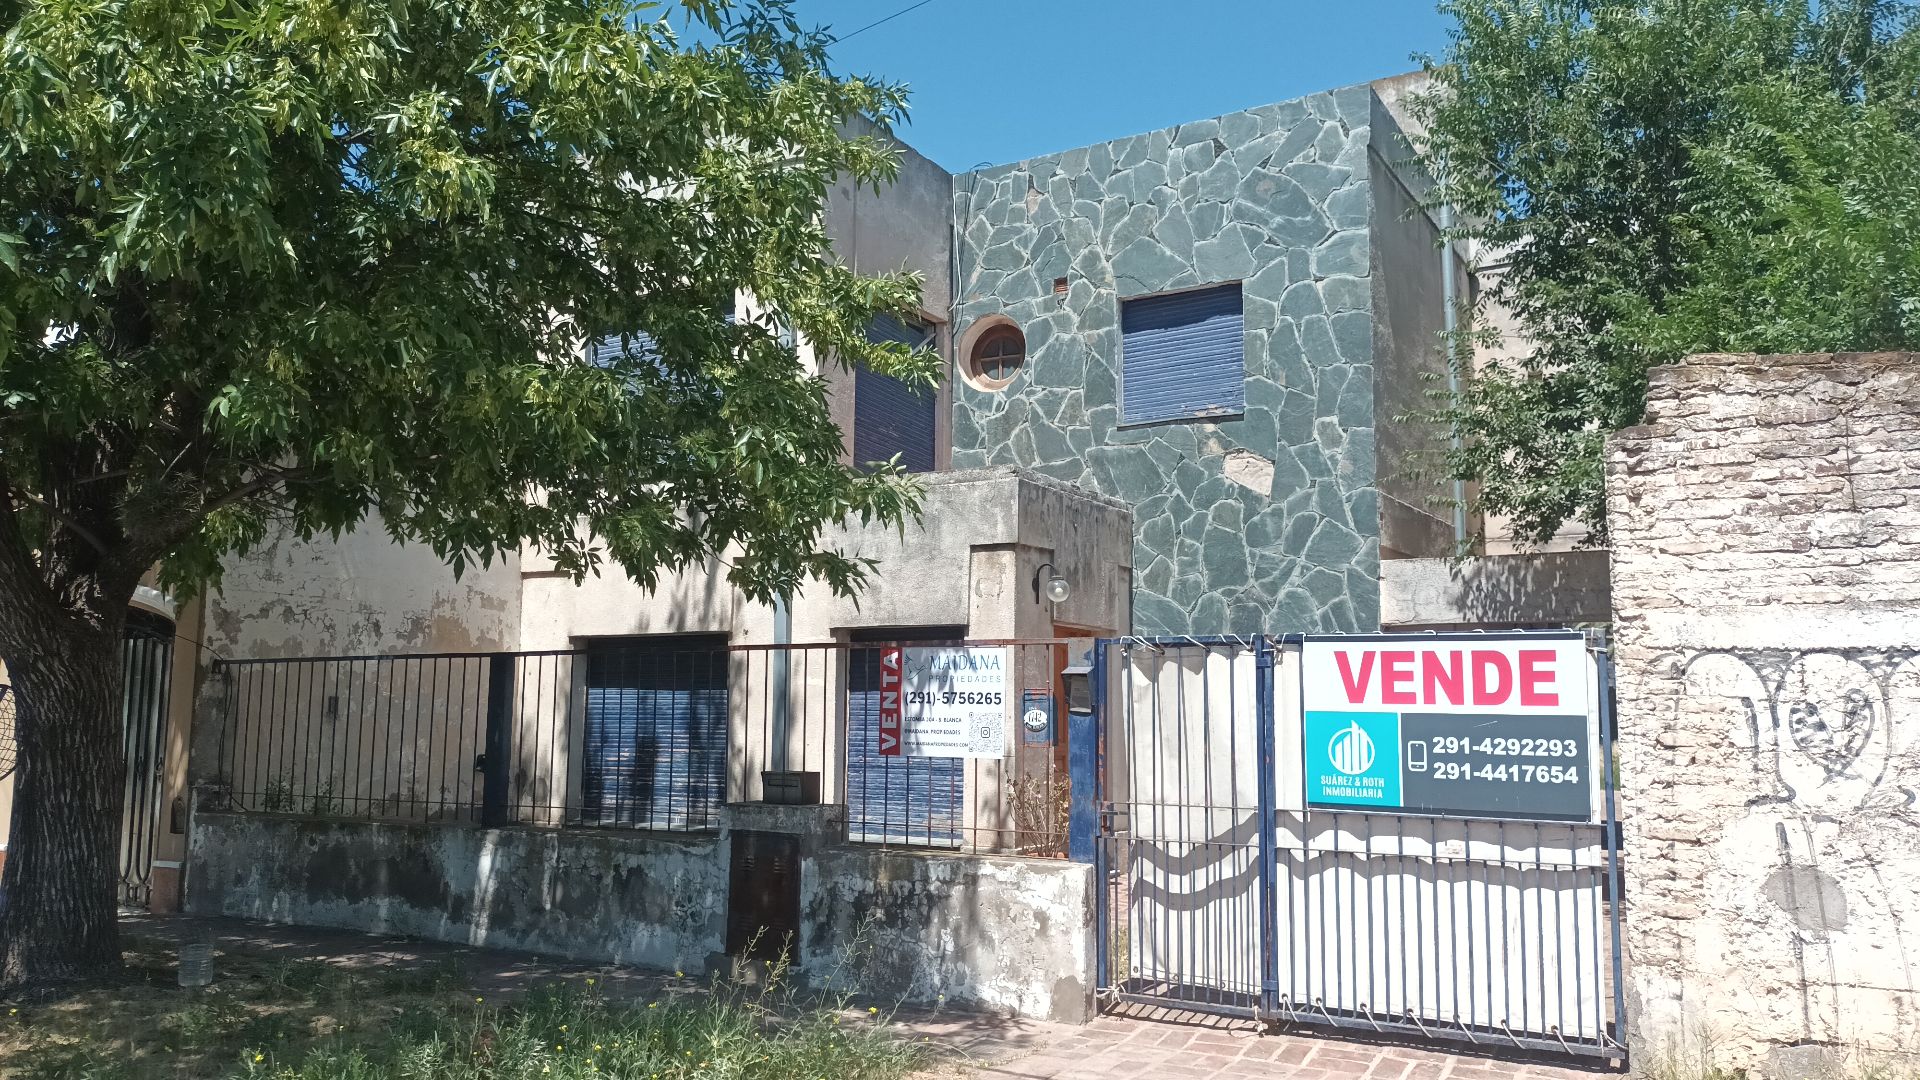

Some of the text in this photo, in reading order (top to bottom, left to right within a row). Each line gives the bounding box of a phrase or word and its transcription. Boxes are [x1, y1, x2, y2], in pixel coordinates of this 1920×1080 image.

[929, 654, 1001, 670] MAIDANA
[928, 675, 1001, 683] PROPIEDADES
[1334, 650, 1559, 706] VENDE
[881, 651, 899, 751] VENTA
[904, 691, 1002, 706] (291)-5756265
[1432, 736, 1578, 757] 291-4292293
[1320, 774, 1385, 788] SUÁREZ & ROTH
[1433, 762, 1579, 784] 291-4417654
[1322, 786, 1383, 799] INMOBILIARIA
